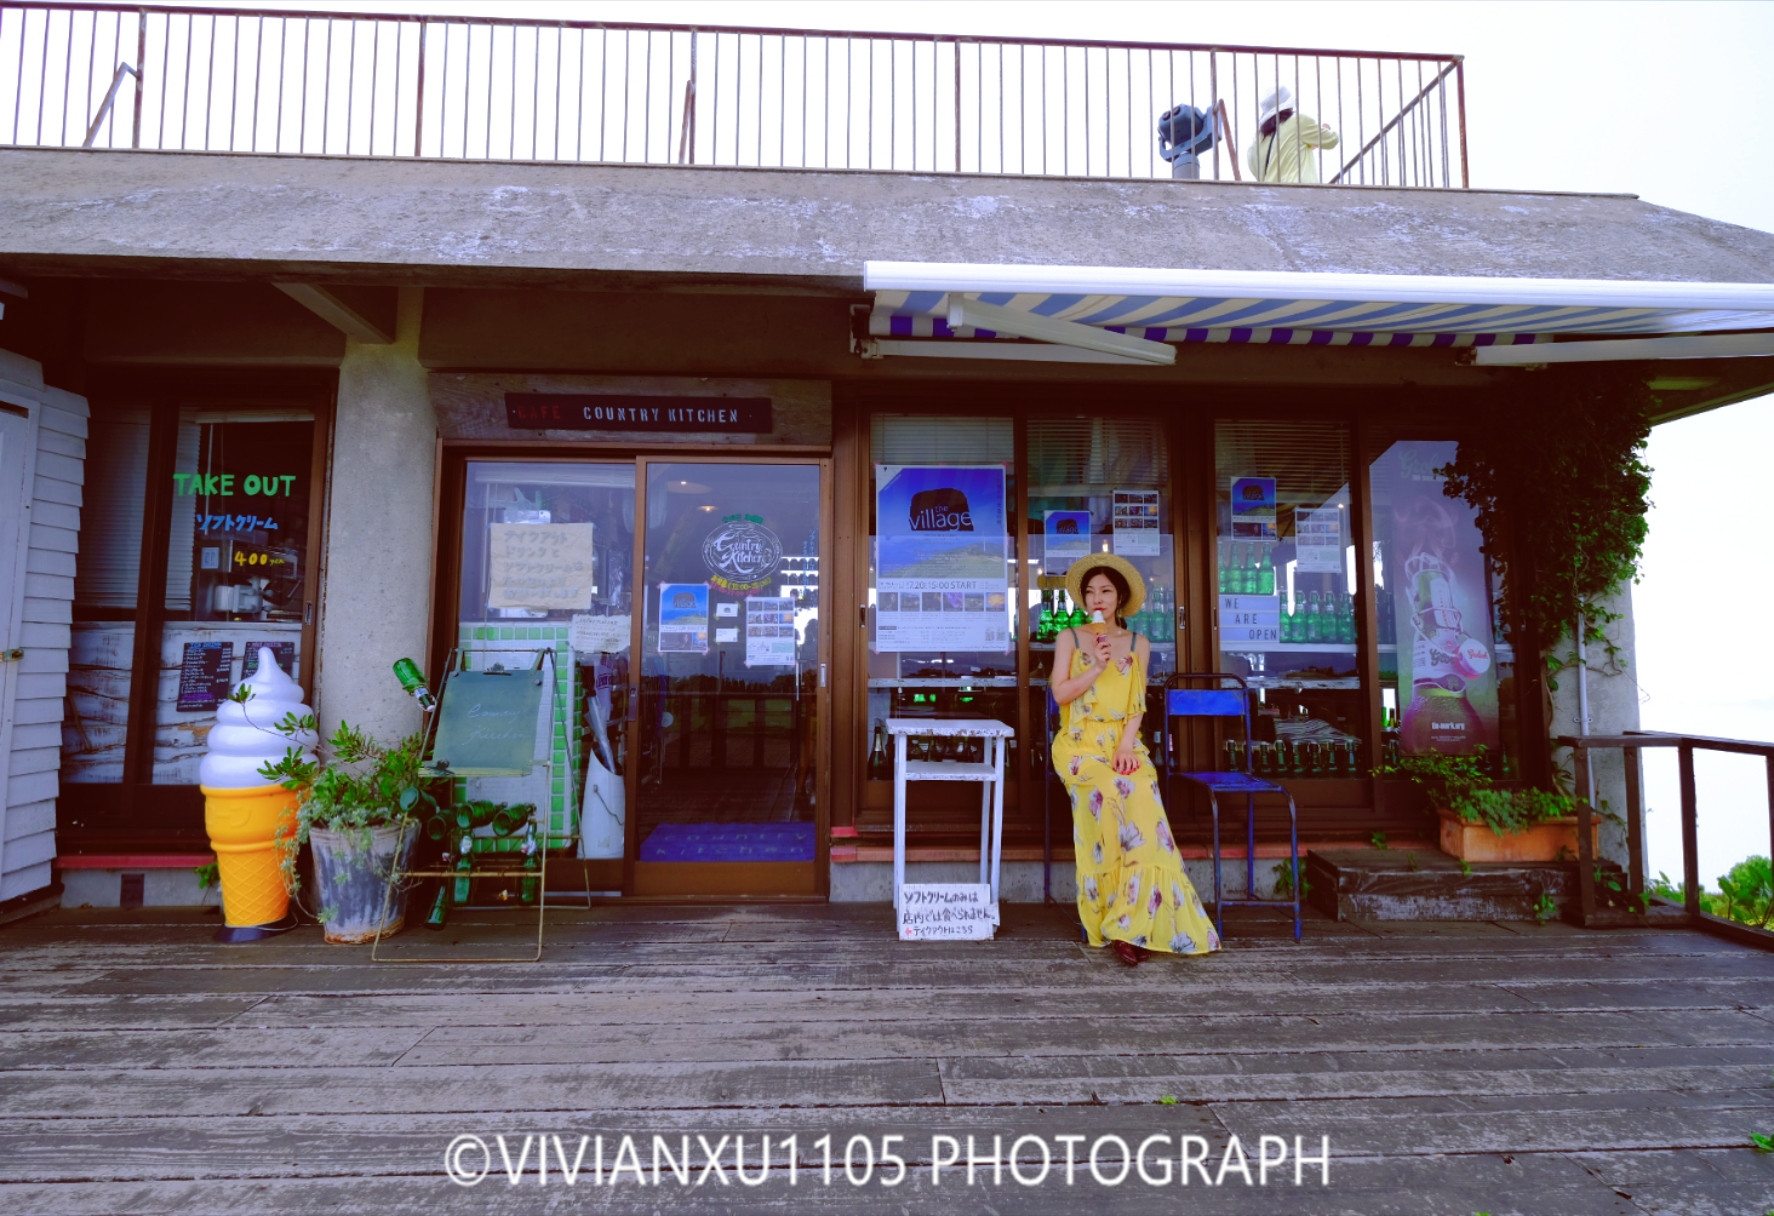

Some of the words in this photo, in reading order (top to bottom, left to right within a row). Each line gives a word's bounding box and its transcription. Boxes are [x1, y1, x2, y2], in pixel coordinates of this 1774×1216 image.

[517, 404, 562, 420] CAFE
[583, 406, 660, 423] COUNTRY
[668, 407, 739, 424] KITCHEN
[173, 473, 235, 497] TAKE
[243, 473, 297, 497] OUT
[196, 513, 279, 532] ソフトクリーム
[909, 508, 973, 531] village
[233, 550, 269, 567] 400
[950, 580, 977, 590] START
[1224, 597, 1239, 610] WE
[1234, 613, 1258, 625] ARE
[1248, 629, 1277, 641] OPEN
[904, 890, 979, 905] ソフトクリームのみは
